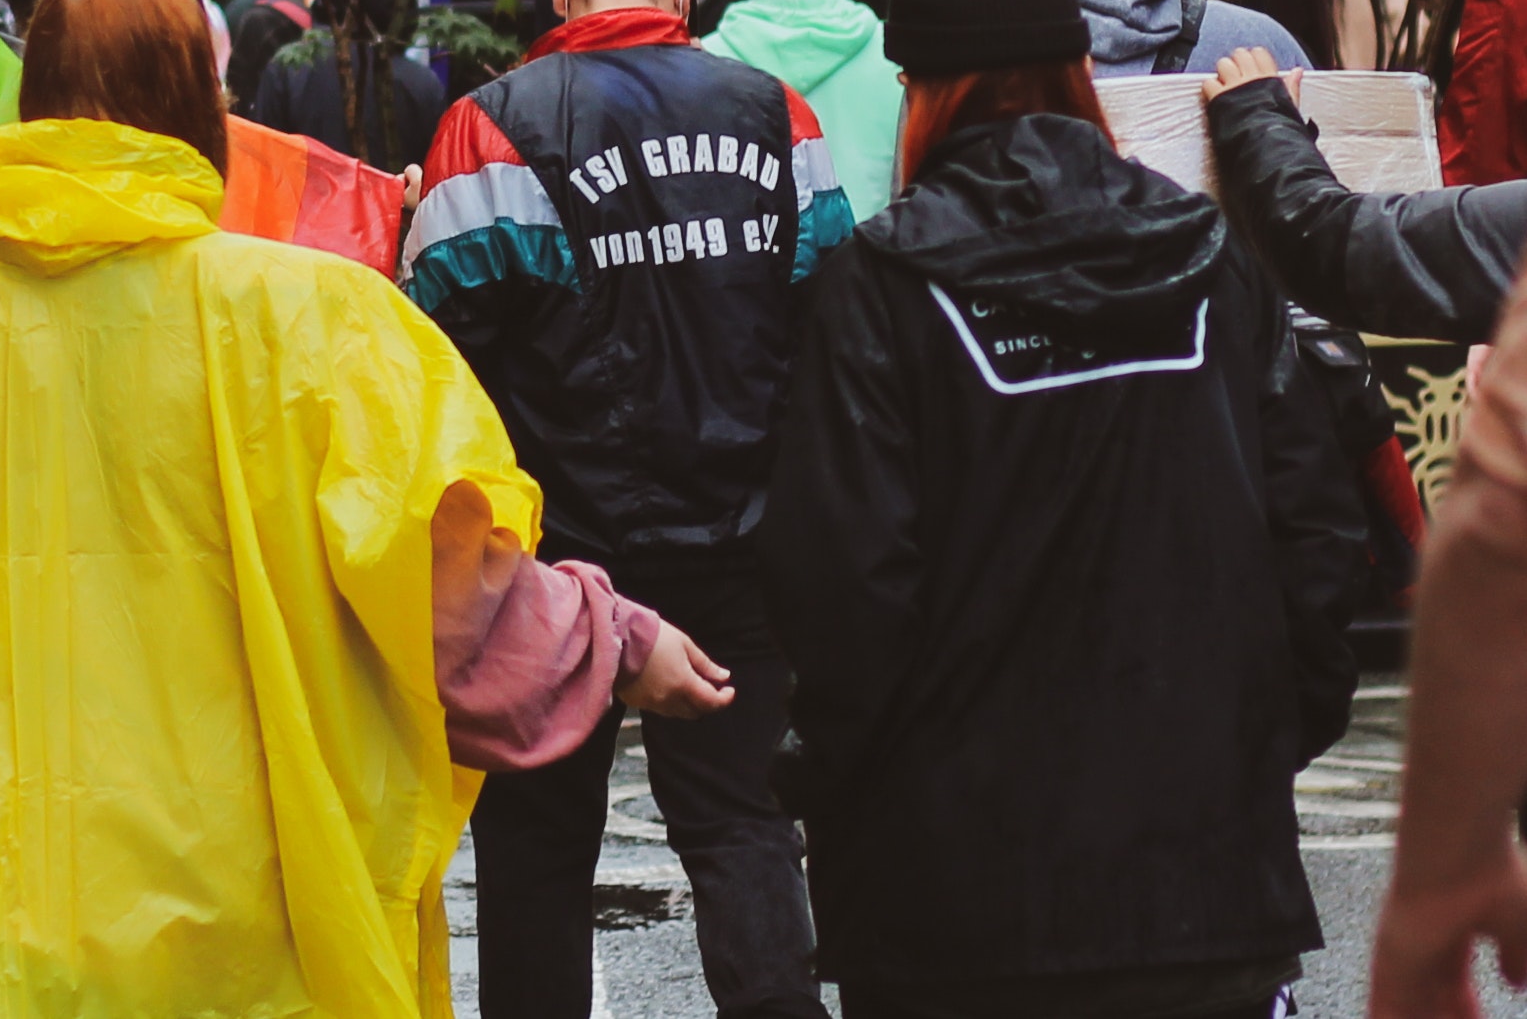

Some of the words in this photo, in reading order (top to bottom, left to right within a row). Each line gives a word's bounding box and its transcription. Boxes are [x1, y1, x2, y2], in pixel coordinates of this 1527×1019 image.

[569, 146, 628, 204] TSV
[640, 133, 781, 192] GRABAU
[589, 230, 644, 270] von
[648, 217, 728, 266] 1949
